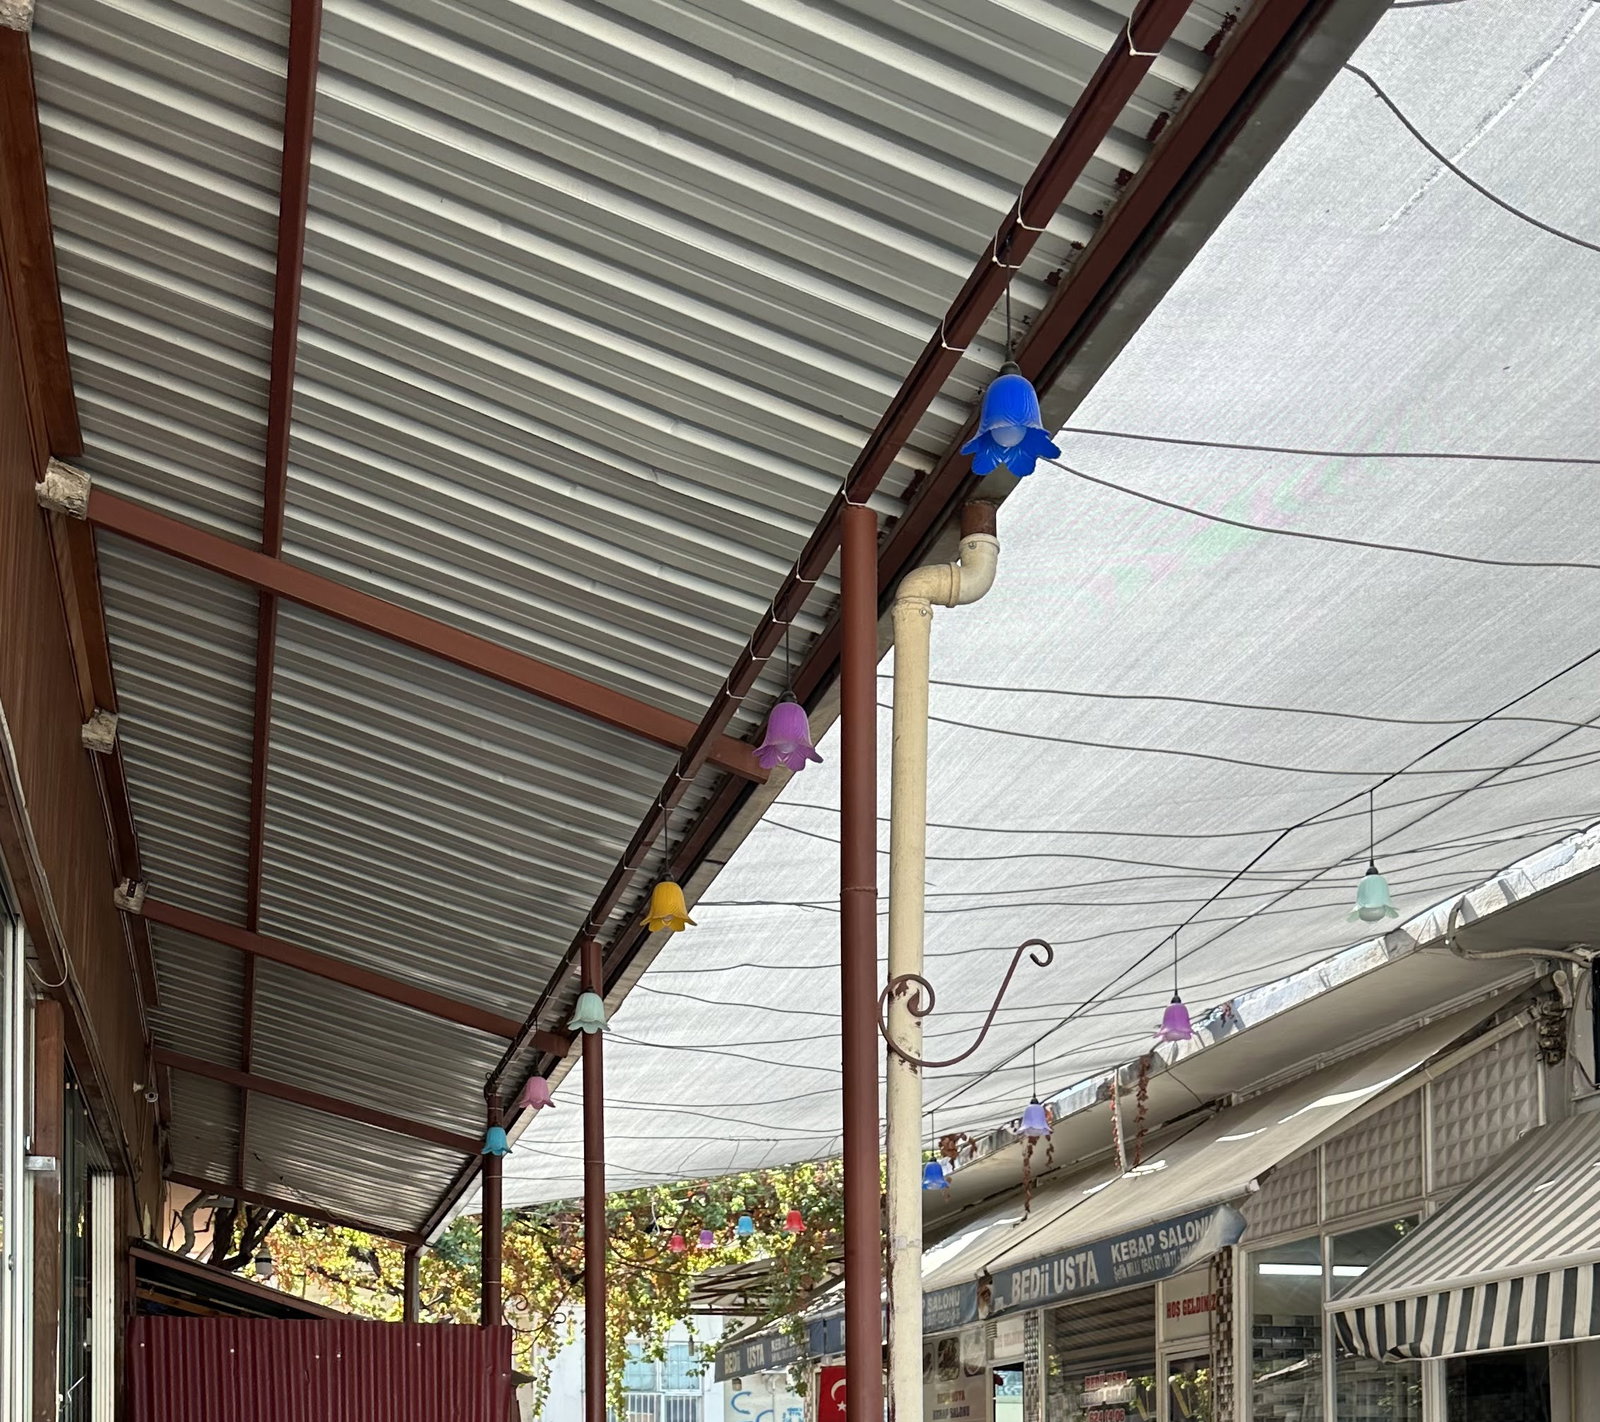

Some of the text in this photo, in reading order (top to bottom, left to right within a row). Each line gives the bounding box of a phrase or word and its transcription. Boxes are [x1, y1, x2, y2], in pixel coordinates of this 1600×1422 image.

[1111, 1233, 1155, 1263] KEBAP
[1053, 1250, 1099, 1294] USTA
[927, 1289, 961, 1313] SALONU
[746, 1343, 765, 1369] USTA
